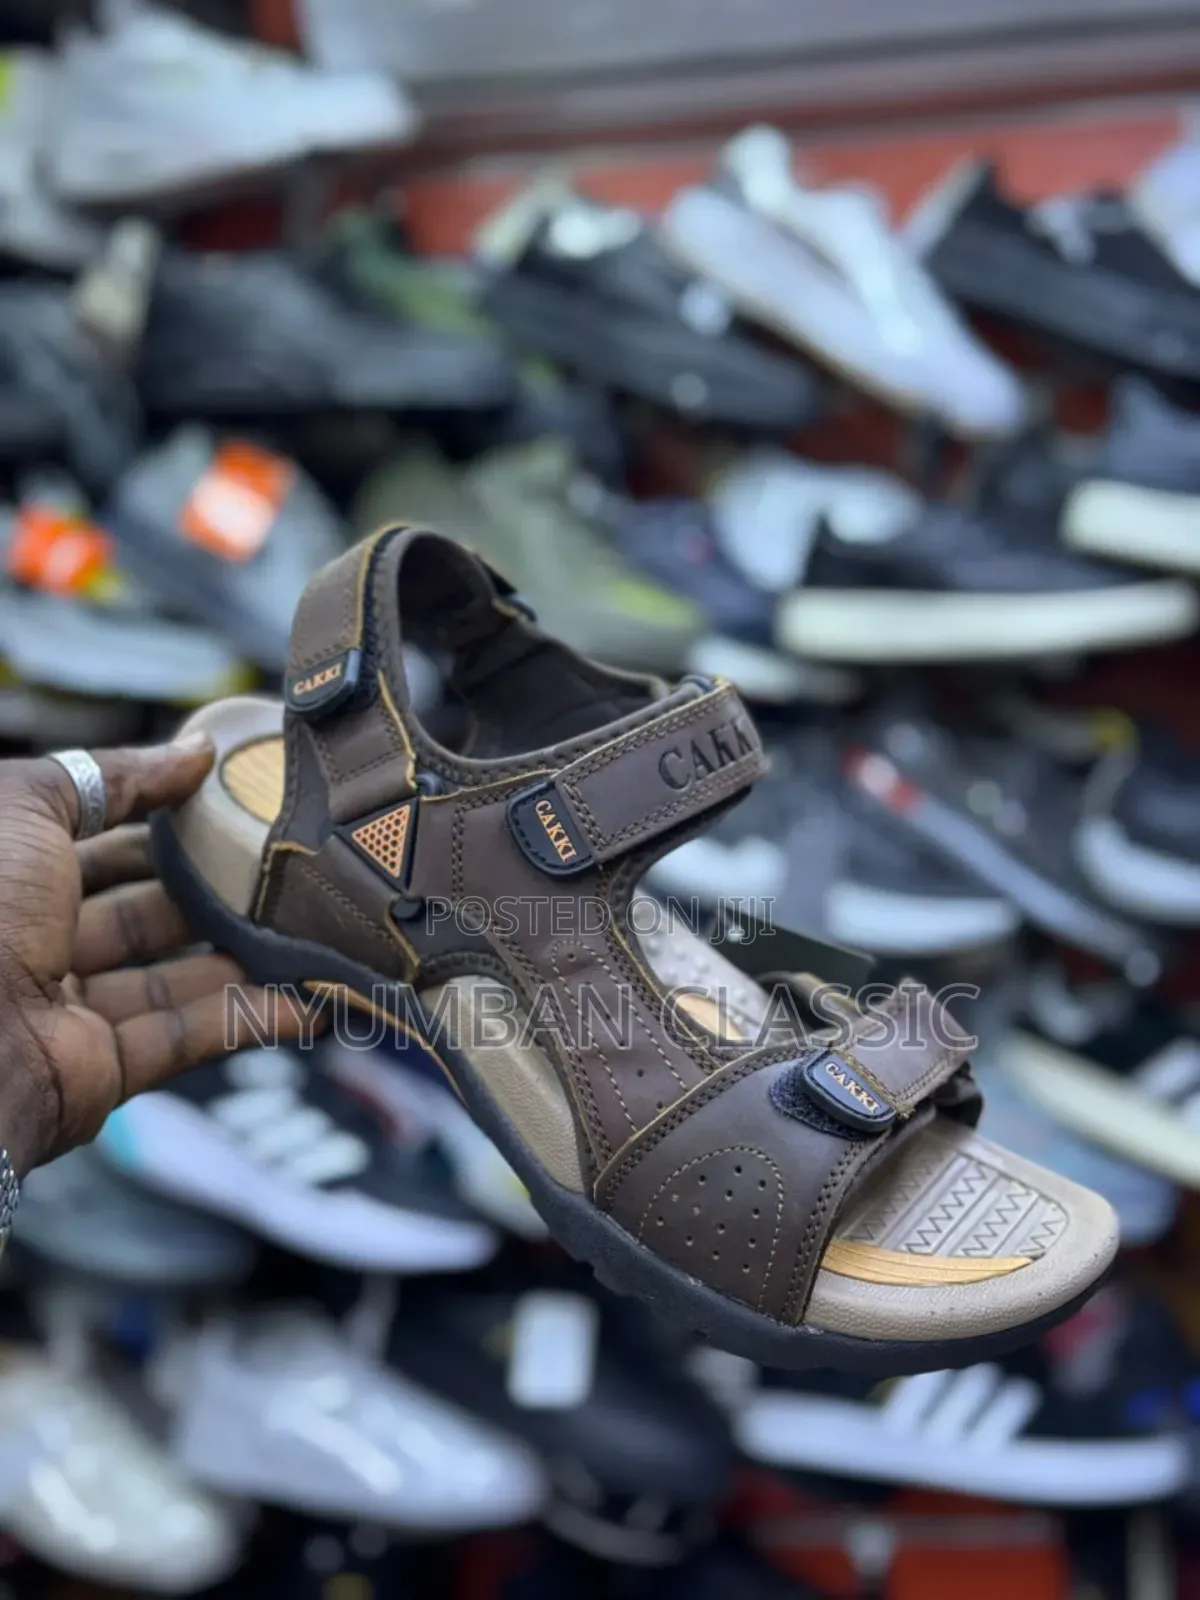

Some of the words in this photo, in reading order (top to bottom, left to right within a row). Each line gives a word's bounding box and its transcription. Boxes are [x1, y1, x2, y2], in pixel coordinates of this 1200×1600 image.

[293, 663, 342, 696] CAKKI
[534, 800, 578, 863] CAKKI
[825, 1062, 881, 1114] CAKKI
